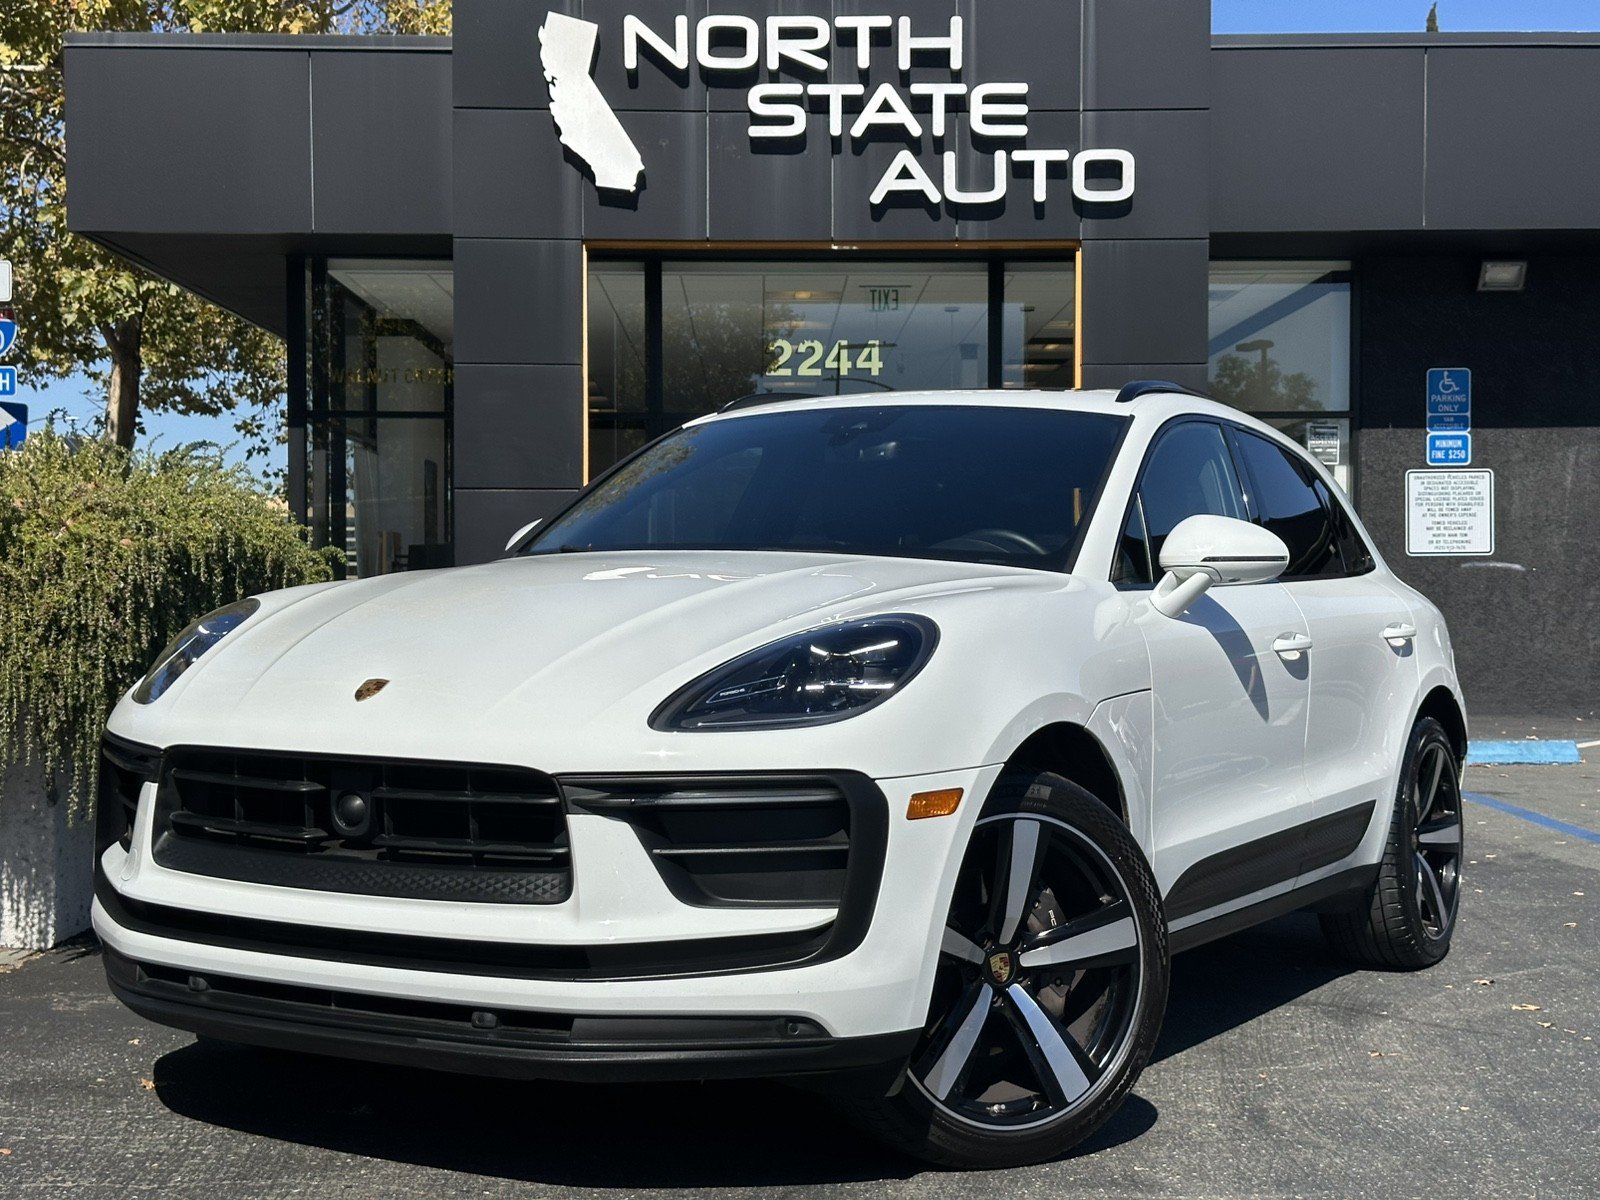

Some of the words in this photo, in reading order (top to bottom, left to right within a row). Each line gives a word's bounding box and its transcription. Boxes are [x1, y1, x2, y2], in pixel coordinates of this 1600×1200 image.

[624, 15, 962, 70] NORTH
[748, 83, 1028, 137] STATE
[870, 149, 1135, 204] AUTO
[765, 338, 884, 376] 2244
[1430, 394, 1467, 403] PARKING
[1437, 404, 1459, 412] ONLY
[1431, 449, 1446, 459] FINE
[1448, 449, 1466, 459] $250
[1435, 439, 1462, 448] MINIMUM
